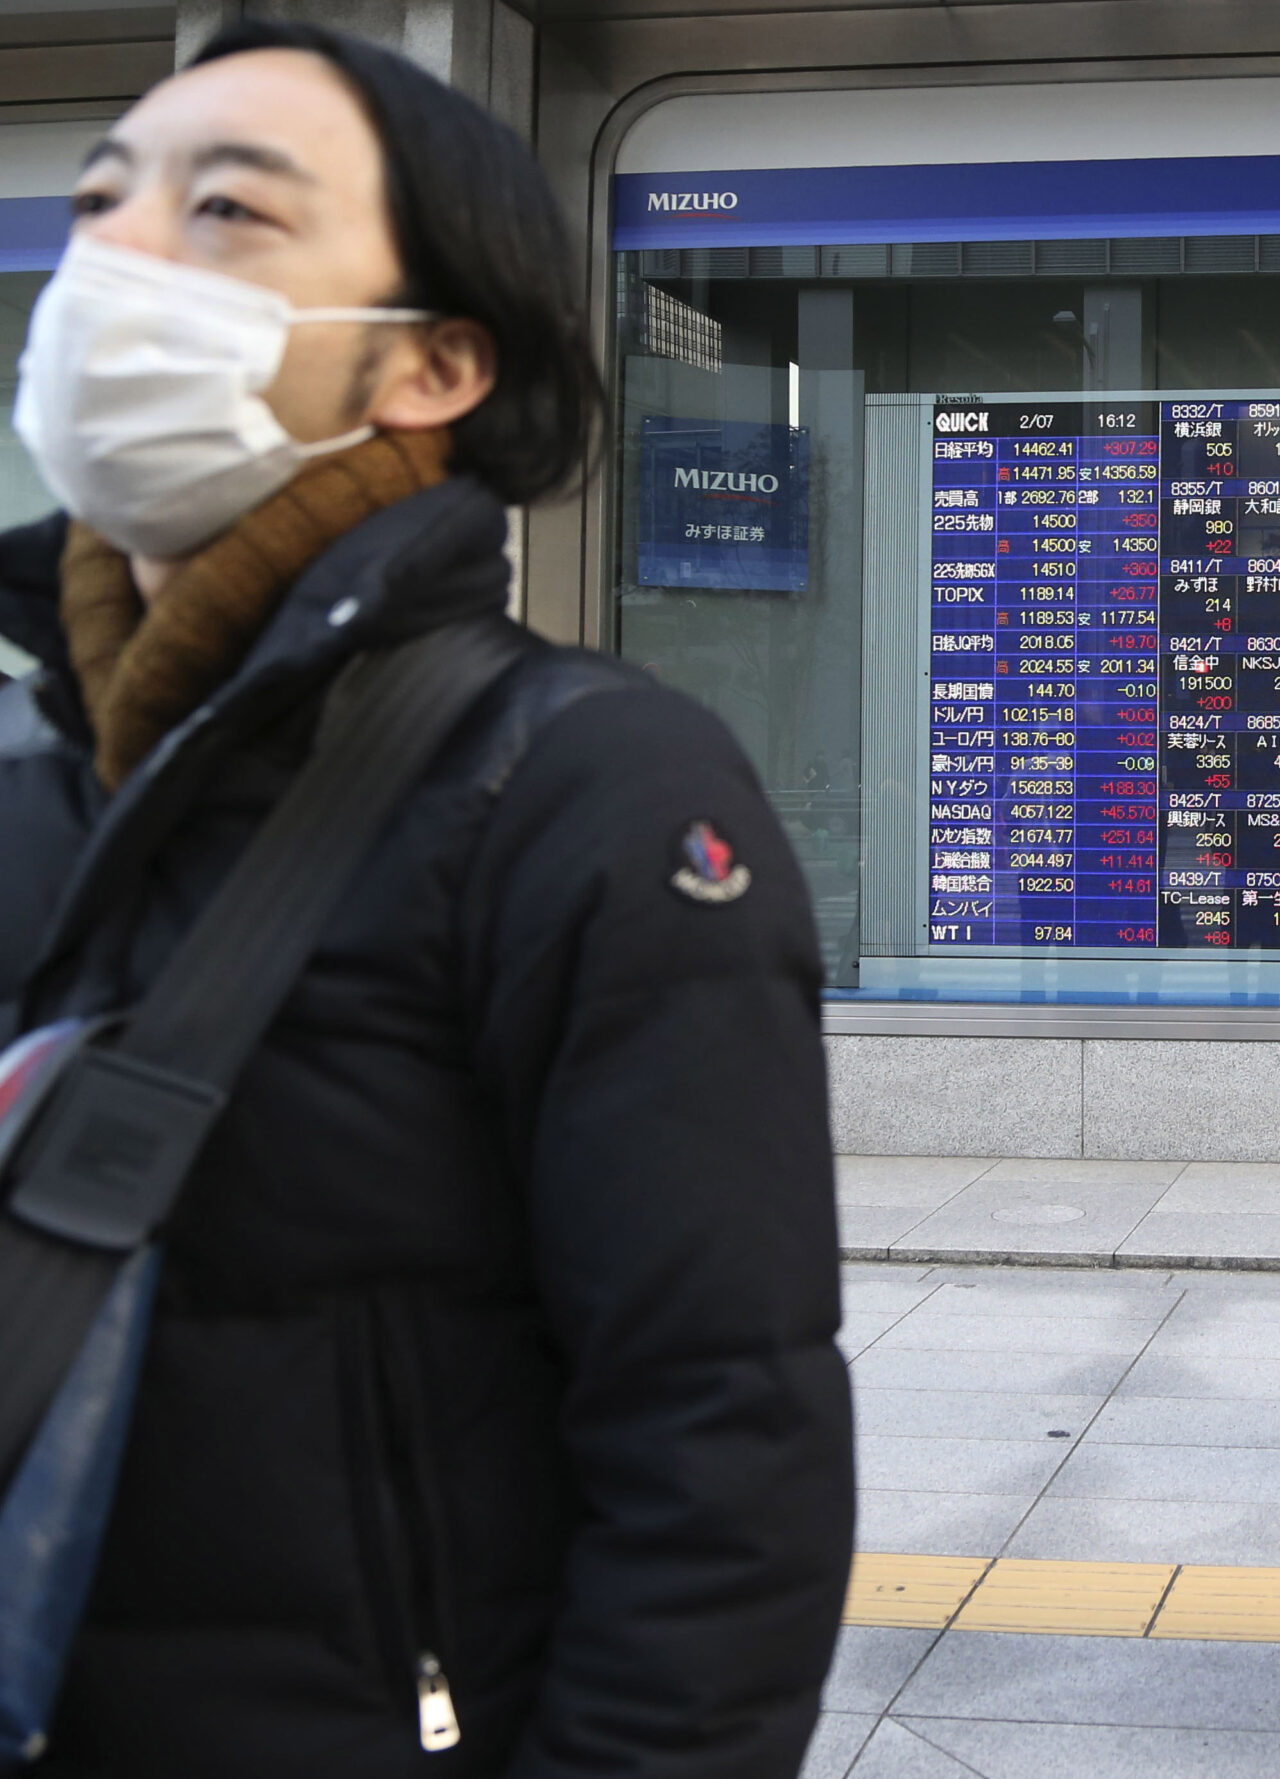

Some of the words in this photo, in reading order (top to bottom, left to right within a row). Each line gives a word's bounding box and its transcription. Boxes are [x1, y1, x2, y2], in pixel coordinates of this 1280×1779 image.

[648, 192, 738, 212] MIZUHO
[1172, 404, 1224, 418] 8332/T
[936, 413, 988, 431] QUICK
[1020, 415, 1053, 428] 2/07
[1098, 414, 1135, 427] 16:12
[1175, 422, 1221, 437] 横浜銀
[934, 441, 993, 458] 日経平均
[1015, 443, 1072, 456] 14462.41
[1207, 443, 1232, 456] 505
[1014, 466, 1075, 479] 14471.95
[1094, 466, 1156, 479] 14356.59
[1208, 462, 1233, 475] +10
[674, 467, 779, 494] MIZUHO
[1171, 481, 1223, 495] 8355/T
[935, 490, 978, 507] 売買高
[1022, 491, 1075, 504] 2692.76
[1119, 490, 1152, 503] 132.1
[1174, 499, 1220, 514] 静岡銀
[935, 514, 993, 530] 225先物
[1034, 515, 1076, 527] 14500
[1206, 521, 1232, 533] 980
[684, 524, 765, 541] みずほ証券
[1033, 539, 1076, 552] 14500
[1114, 538, 1159, 551] 14350
[1033, 563, 1077, 576] 14510
[1171, 559, 1222, 573] 8411/T
[1175, 577, 1217, 592] みずほ
[934, 588, 984, 602] TOPIX
[1021, 587, 1073, 600] 1189.14
[1206, 599, 1230, 611] 214
[1021, 611, 1074, 624] 1189.53
[1102, 611, 1154, 624] 1177.54
[933, 635, 993, 651] 日経JQ平均
[1020, 636, 1073, 648] 2018.05
[1171, 637, 1222, 651] 8421/T
[1020, 660, 1076, 673] 2024.55
[1101, 660, 1154, 673] 2011.34
[1243, 657, 1280, 669] NKSJ
[1180, 677, 1232, 689] 191500
[933, 683, 993, 700] 長期国債
[1028, 684, 1076, 697] 144.70
[935, 707, 983, 722] ドル/円
[1170, 715, 1222, 729] 8424/T
[1168, 733, 1225, 748] 芙蓉リース
[1197, 755, 1230, 768] 3365
[1011, 781, 1072, 794] 15628.53
[1170, 793, 1221, 807] 8425/T
[932, 805, 991, 819] NASDAQ
[1011, 805, 1072, 818] 4057.122
[1168, 811, 1225, 827] 興銀リース
[1011, 830, 1072, 843] 21674.77
[1196, 833, 1231, 846] 2560
[1011, 854, 1072, 867] 2044.497
[932, 875, 992, 892] 韓国総合
[1019, 878, 1075, 892] 1922.50
[1170, 872, 1221, 885] 8439/T
[1161, 892, 1230, 904] TC-Lease
[932, 900, 994, 917] ムンバイ
[1196, 912, 1229, 925] 2845
[1035, 927, 1072, 940] 97.84
